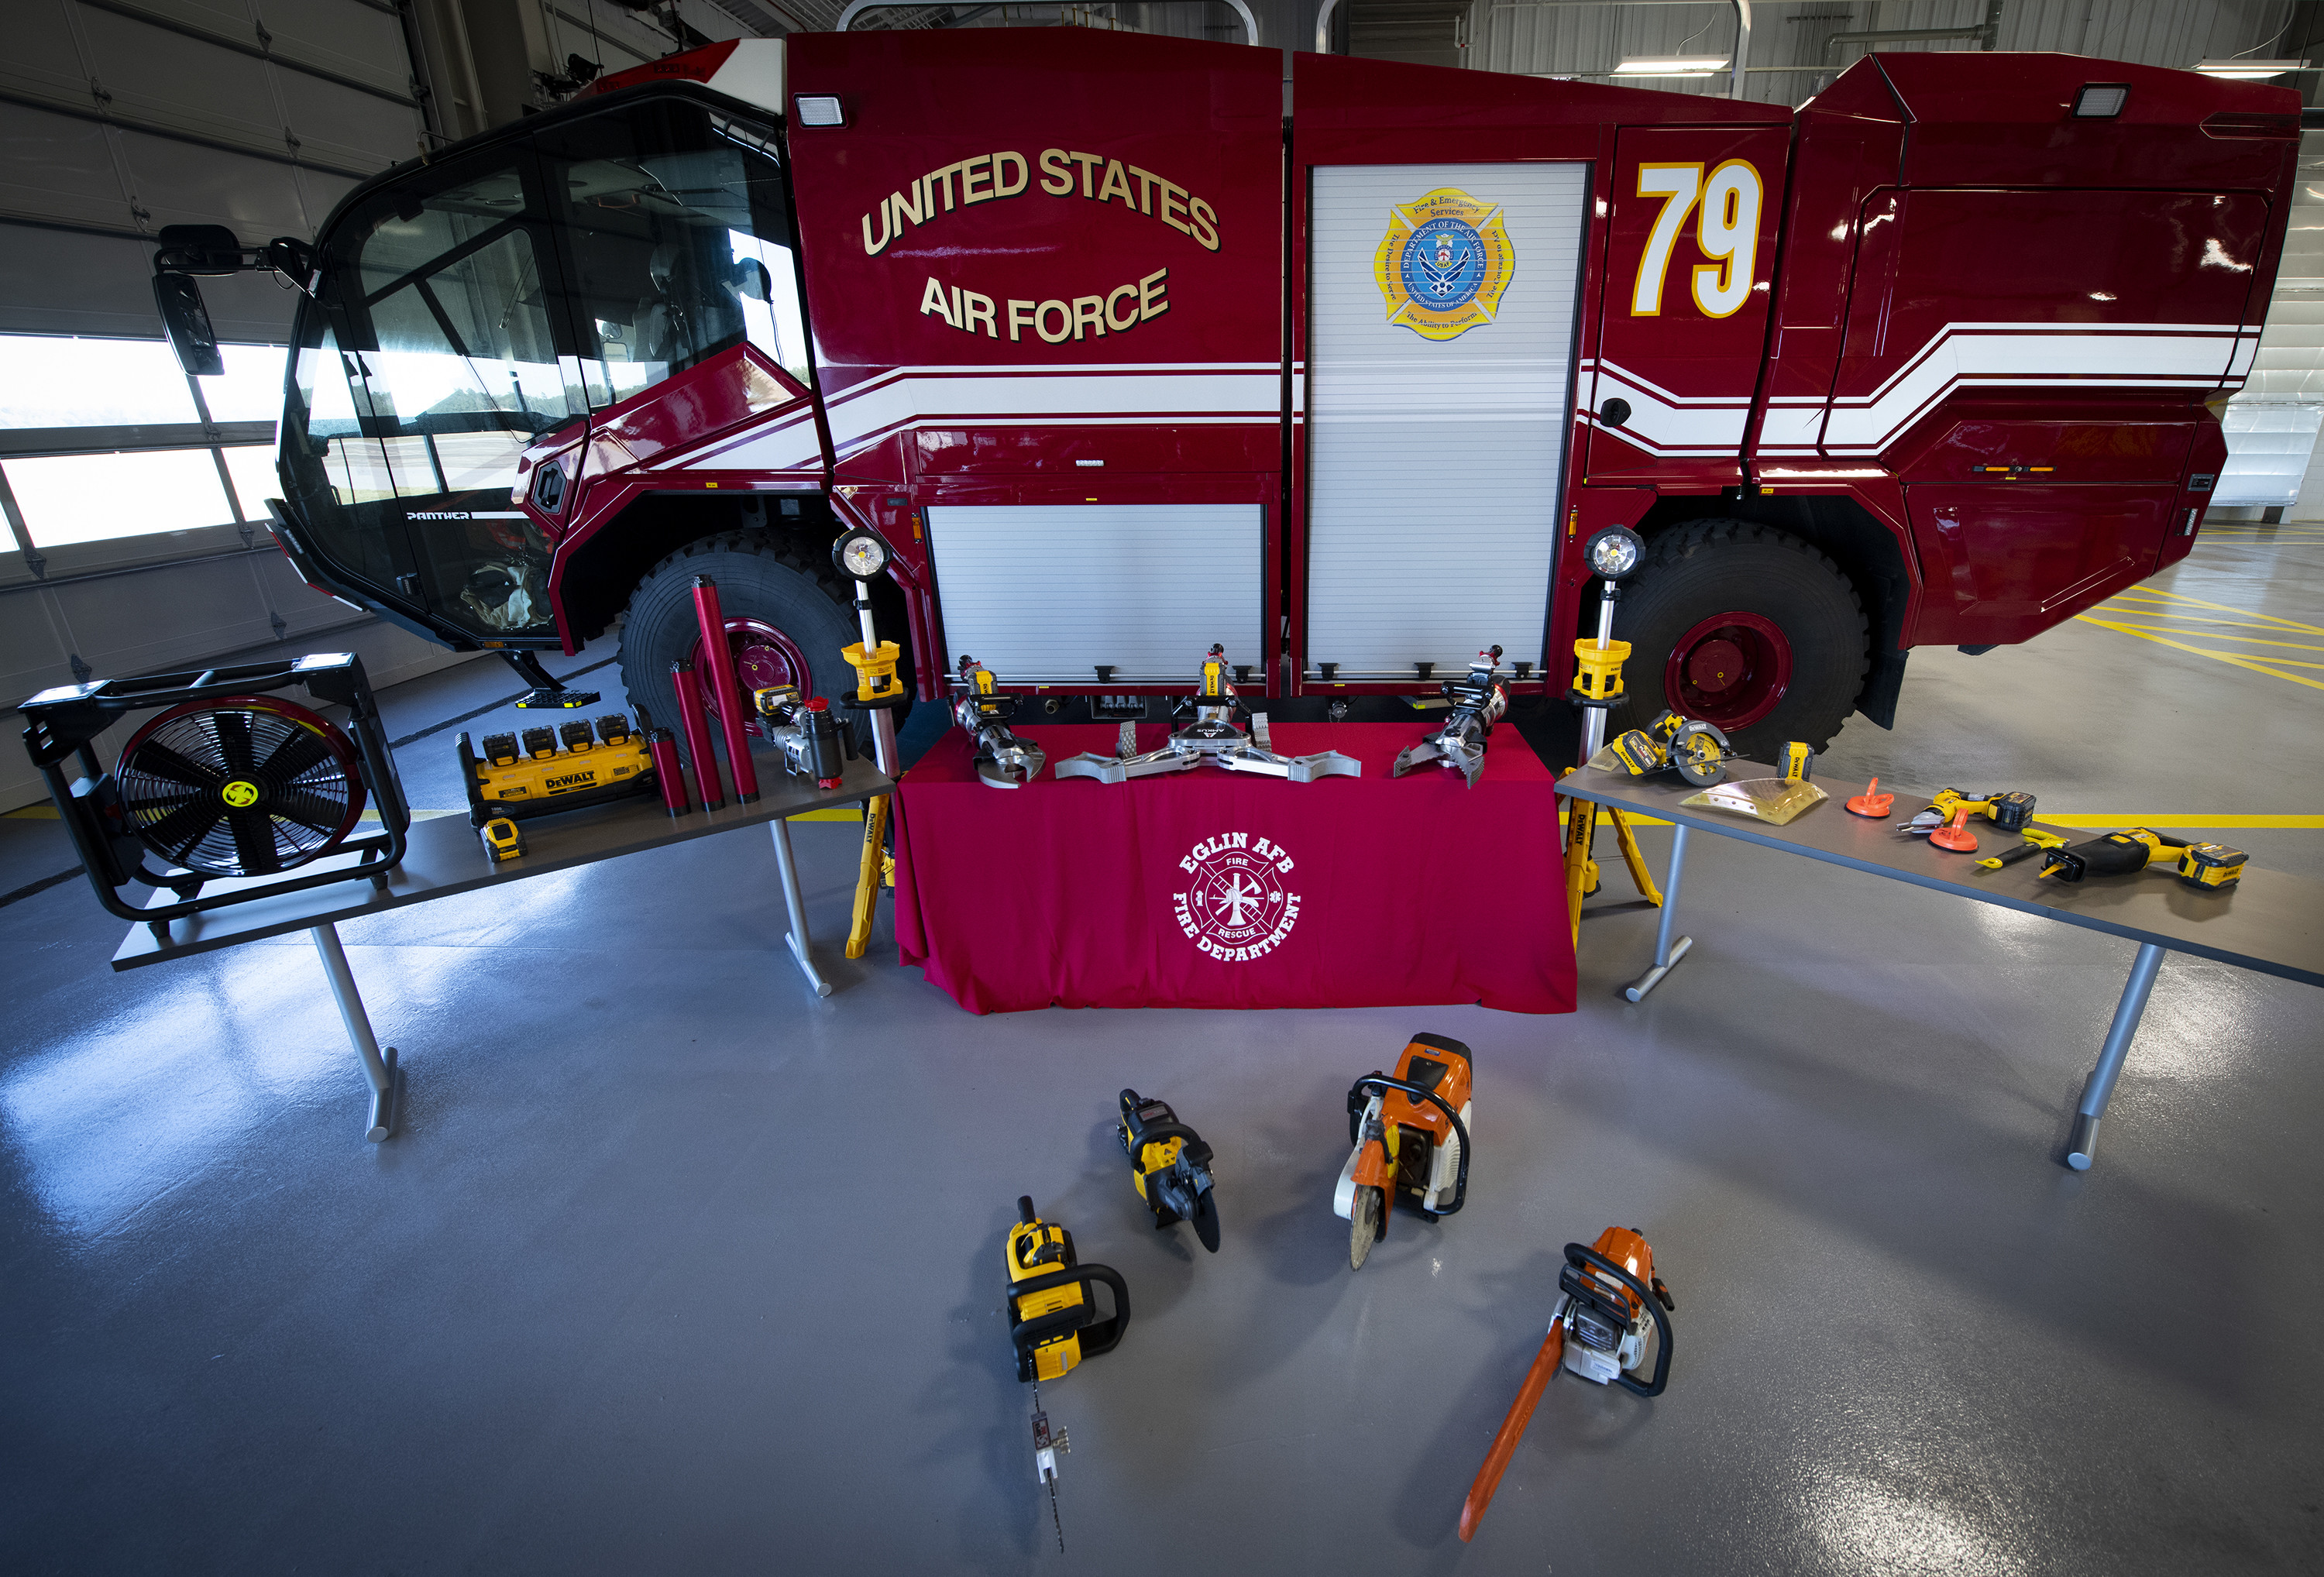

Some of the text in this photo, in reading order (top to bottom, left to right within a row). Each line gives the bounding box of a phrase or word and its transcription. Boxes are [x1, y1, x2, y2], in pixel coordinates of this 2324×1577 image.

[861, 148, 1221, 257] UNITED STATES
[1413, 203, 1428, 214] Fire
[1439, 197, 1480, 213] Emergency
[1430, 208, 1464, 217] Services
[1404, 222, 1436, 268] DEPARTMENT
[1450, 222, 1466, 232] THE
[1464, 230, 1476, 242] AIR
[1473, 242, 1483, 268] FORCE
[1631, 159, 1763, 318] 79
[1385, 248, 1394, 272] Desire
[1494, 253, 1504, 284] Courage
[920, 267, 1169, 343] AIR FORCE
[1408, 283, 1425, 302] UNITED
[1456, 283, 1477, 303] AMERICA
[1407, 311, 1418, 322] The
[1418, 319, 1441, 330] Ability
[1450, 312, 1477, 328] Perform
[1179, 832, 1294, 874] EGLIN AFB
[1226, 857, 1249, 866] FIRE
[1174, 893, 1301, 961] FIRE DEPARTMENT
[1218, 928, 1256, 939] RESCUE
